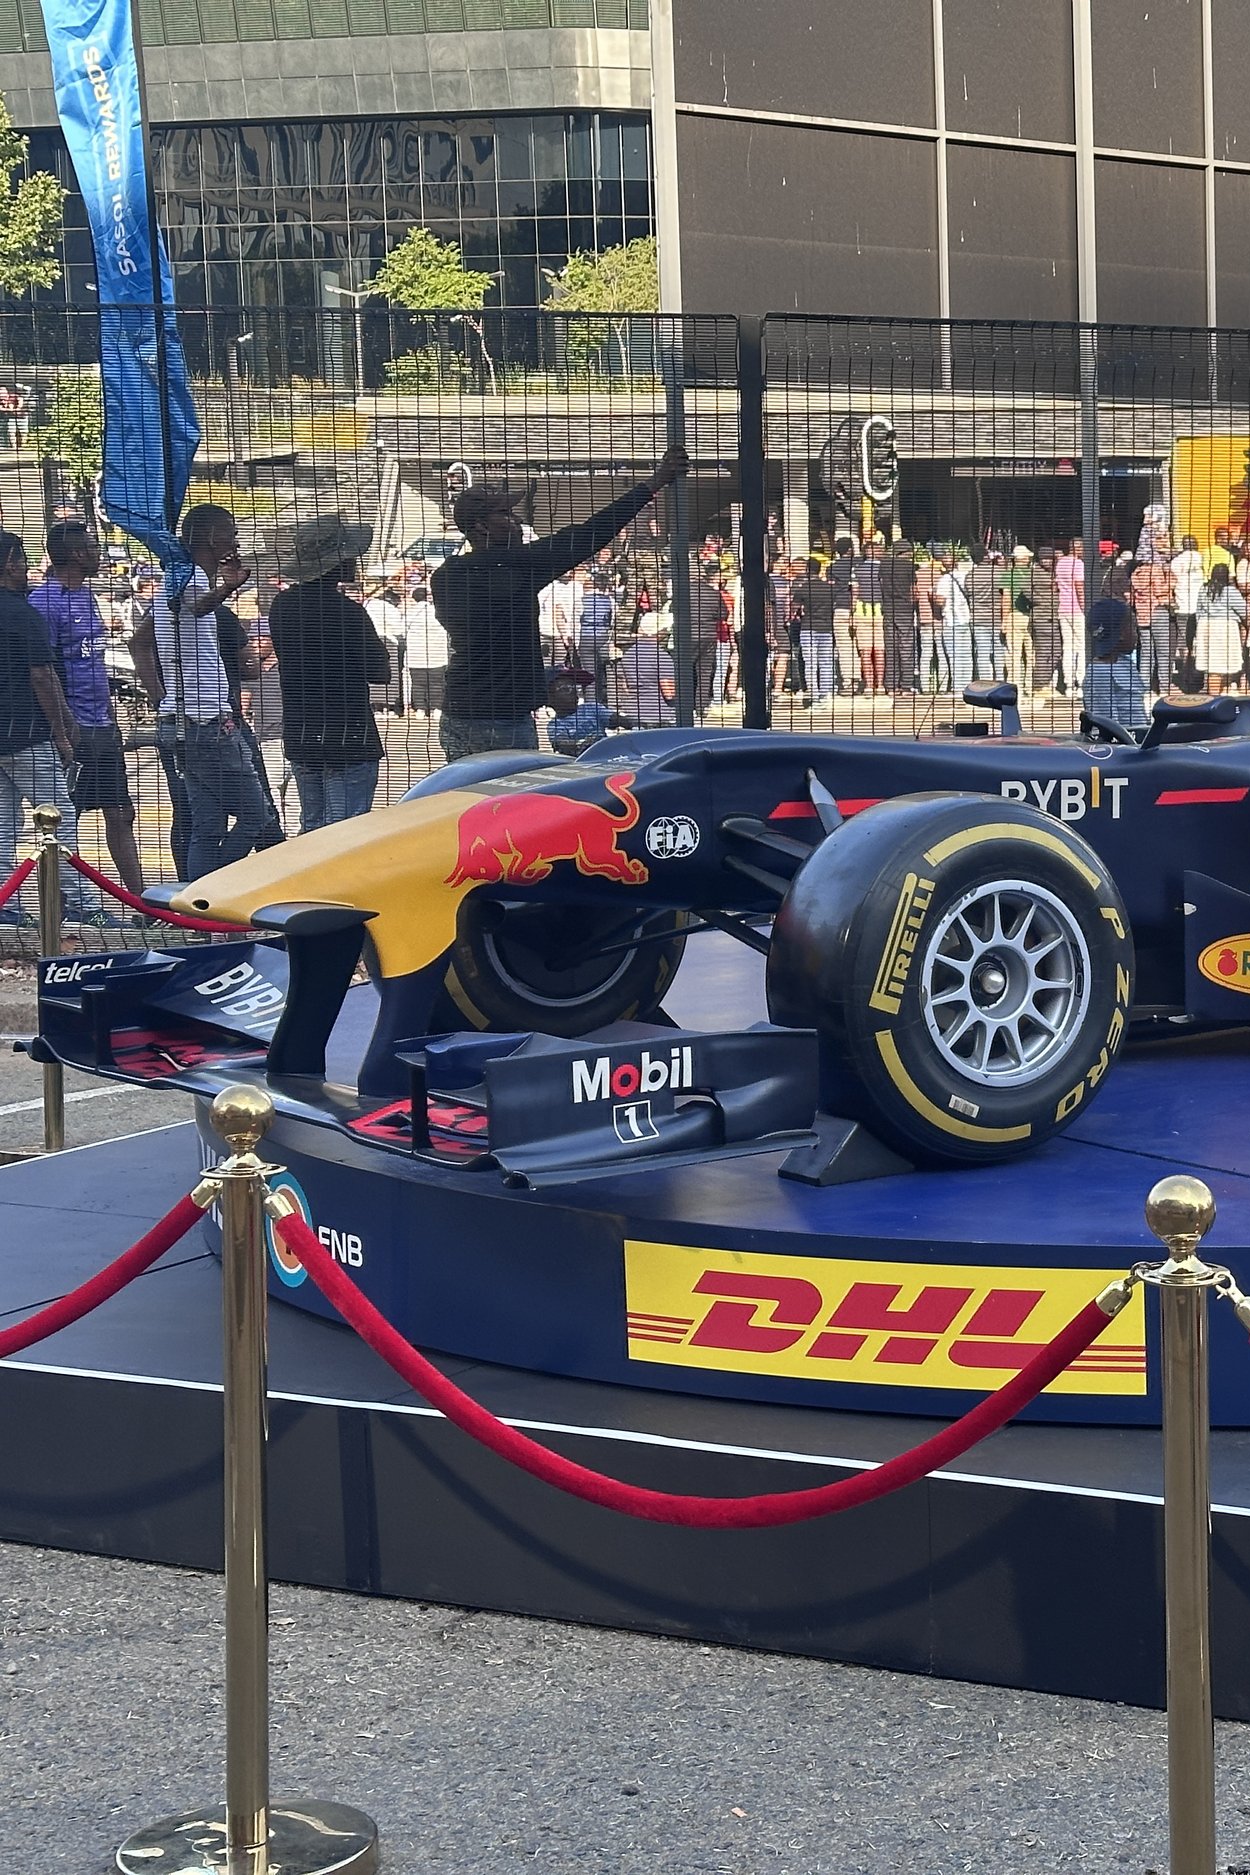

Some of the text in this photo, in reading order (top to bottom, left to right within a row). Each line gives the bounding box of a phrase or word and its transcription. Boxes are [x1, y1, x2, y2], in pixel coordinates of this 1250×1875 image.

[83, 46, 122, 181] REWARDS
[868, 872, 937, 1015] PIRELLI
[571, 1046, 693, 1104] Mobil
[1055, 962, 1131, 1123] ZERO
[624, 1106, 644, 1138] 1
[318, 1225, 364, 1268] FNB
[687, 1269, 1050, 1370] DHL
